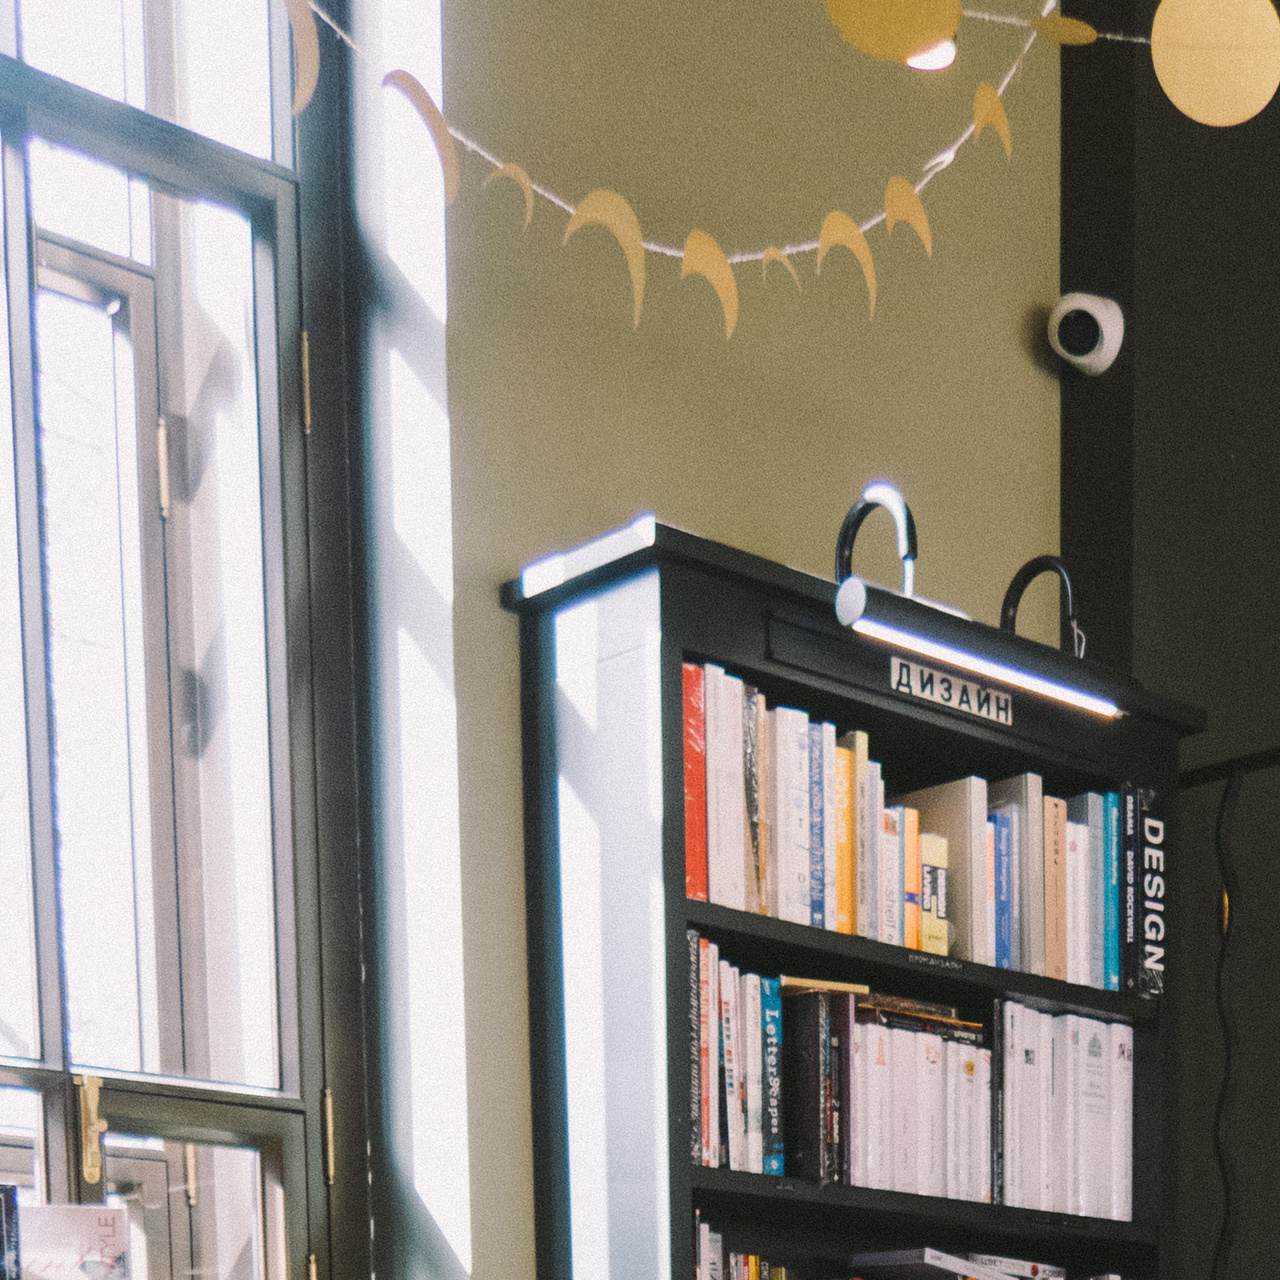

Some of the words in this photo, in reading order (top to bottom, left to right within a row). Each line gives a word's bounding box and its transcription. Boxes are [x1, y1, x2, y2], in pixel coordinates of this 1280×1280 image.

[897, 661, 1010, 723] ДИЗАЙН
[922, 866, 932, 910] LIVING
[936, 869, 948, 918] DESIGN
[1126, 850, 1135, 885] DAVID
[1126, 885, 1135, 943] ROCKWELL
[1143, 817, 1165, 972] DESIGN
